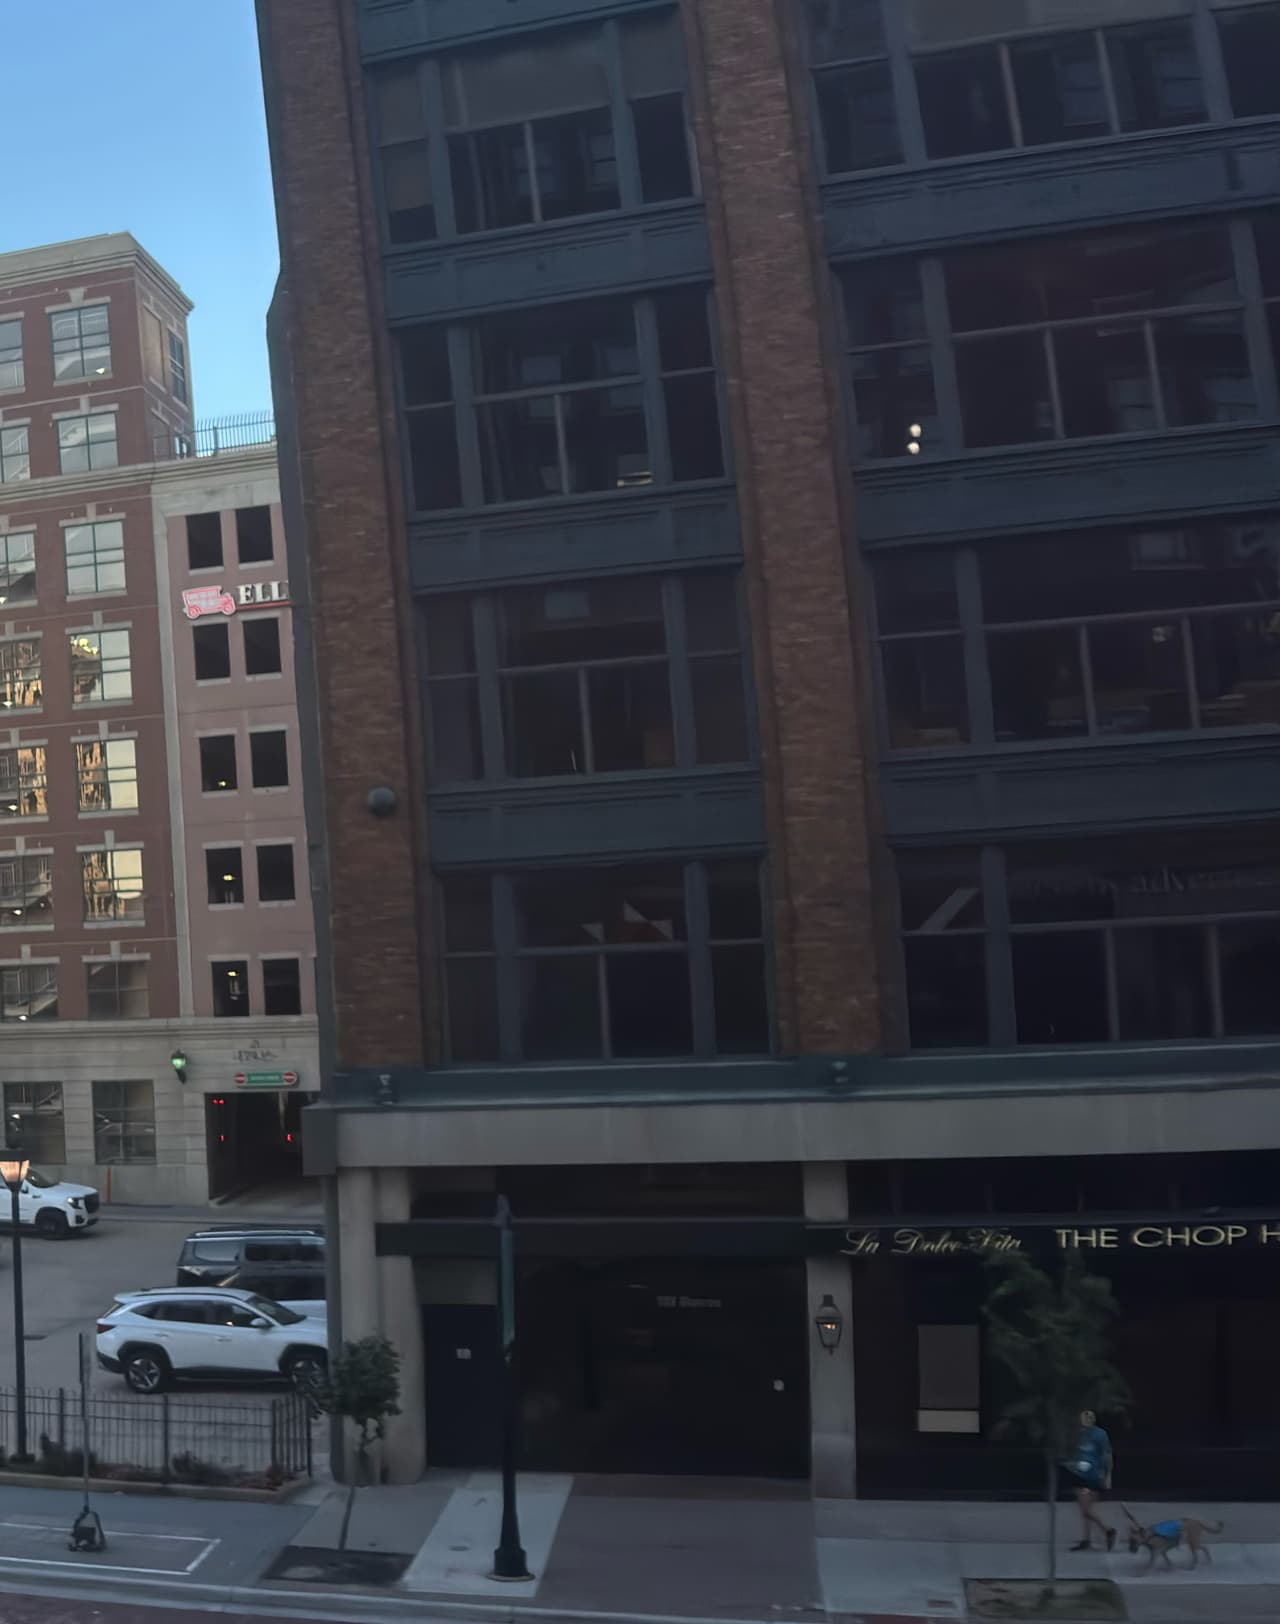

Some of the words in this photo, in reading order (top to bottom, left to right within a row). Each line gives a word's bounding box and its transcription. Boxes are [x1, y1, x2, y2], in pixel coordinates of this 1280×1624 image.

[237, 581, 288, 604] ELL
[1056, 1229, 1120, 1249] THE
[1132, 1226, 1248, 1248] CHOP
